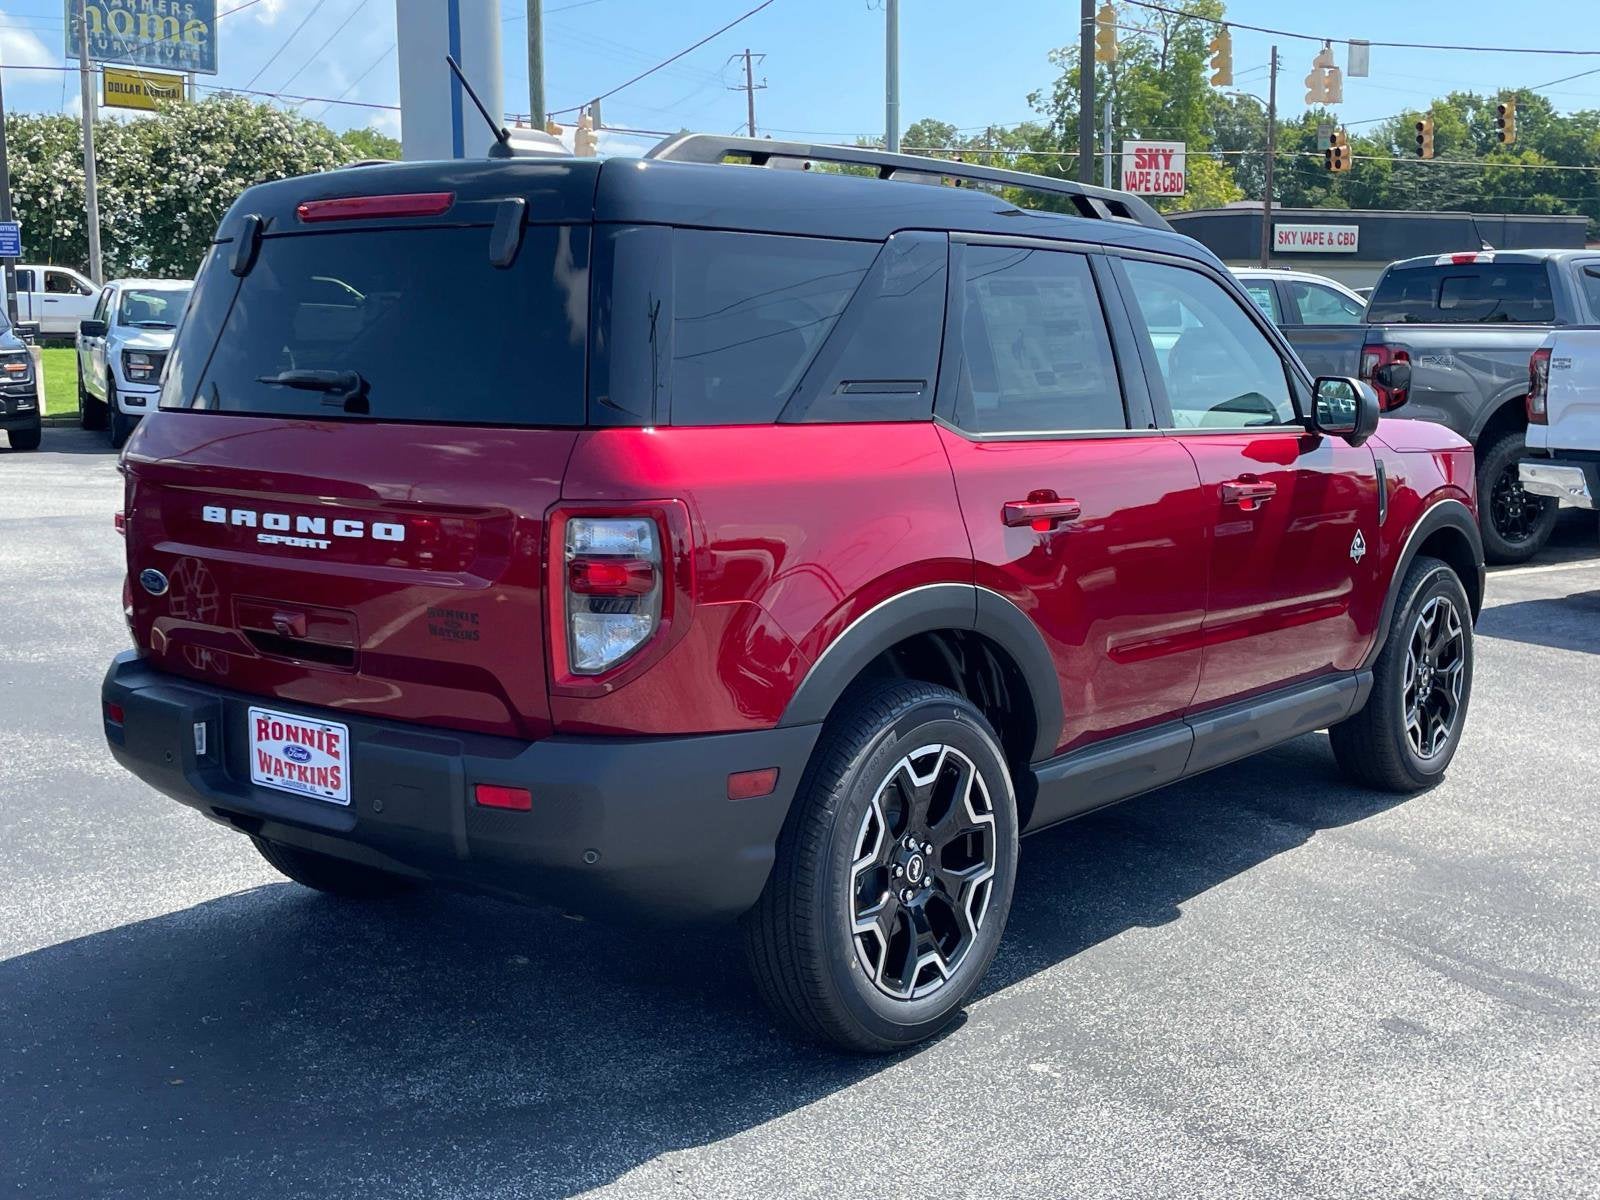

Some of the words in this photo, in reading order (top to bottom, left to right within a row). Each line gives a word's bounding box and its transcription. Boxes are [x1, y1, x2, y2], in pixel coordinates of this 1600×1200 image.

[99, 0, 194, 15] ARMERS
[108, 82, 141, 96] DOLLAR
[1134, 147, 1175, 170] SKY
[1125, 171, 1151, 192] VAPE
[1162, 172, 1183, 193] CBD
[1278, 231, 1297, 244] SKY
[1300, 231, 1324, 245] VAPE
[1327, 231, 1333, 245] &
[1337, 231, 1355, 246] CBD
[203, 506, 405, 542] BRONCO
[257, 534, 331, 549] SPORT
[256, 718, 340, 760] RONNIE
[286, 746, 309, 761] Ford
[257, 748, 341, 790] WATKINS
